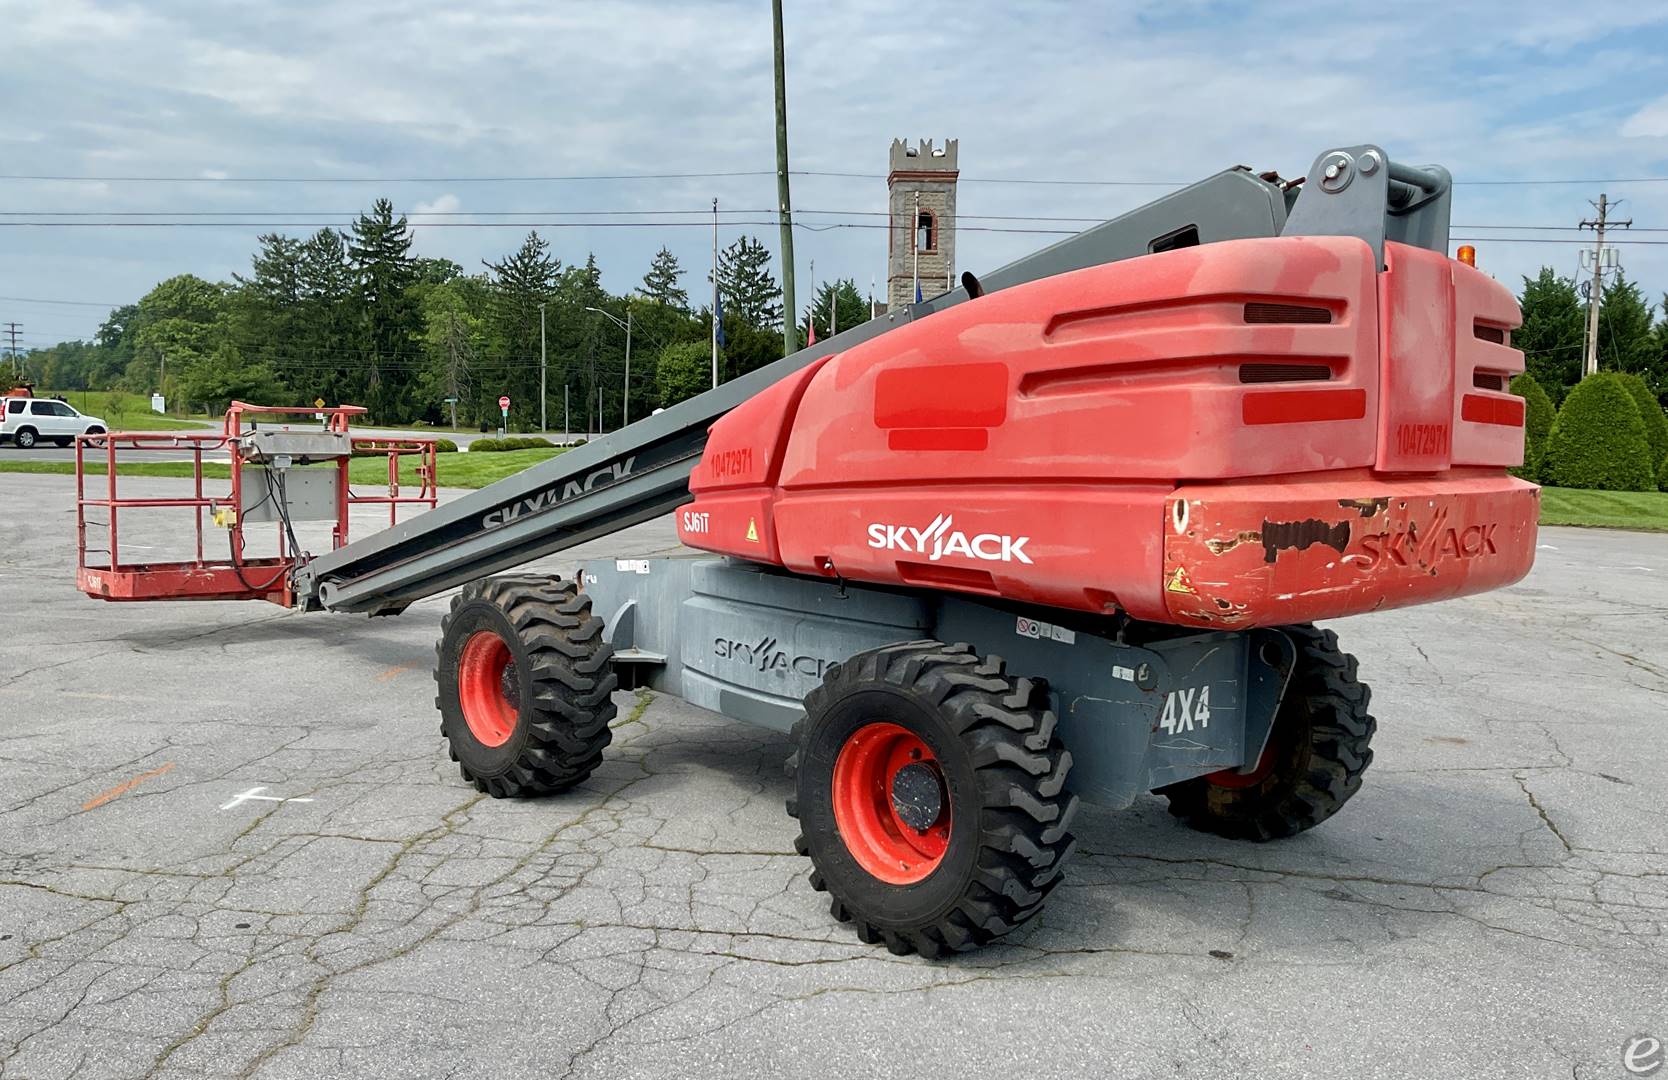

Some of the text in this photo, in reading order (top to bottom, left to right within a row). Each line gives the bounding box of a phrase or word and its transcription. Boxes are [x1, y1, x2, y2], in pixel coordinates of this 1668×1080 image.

[1397, 424, 1448, 455] 10472971
[711, 447, 753, 479] 10472971
[684, 511, 709, 533] SJ61T
[868, 513, 1034, 564] SKYJACK
[1160, 686, 1210, 735] 4X4
